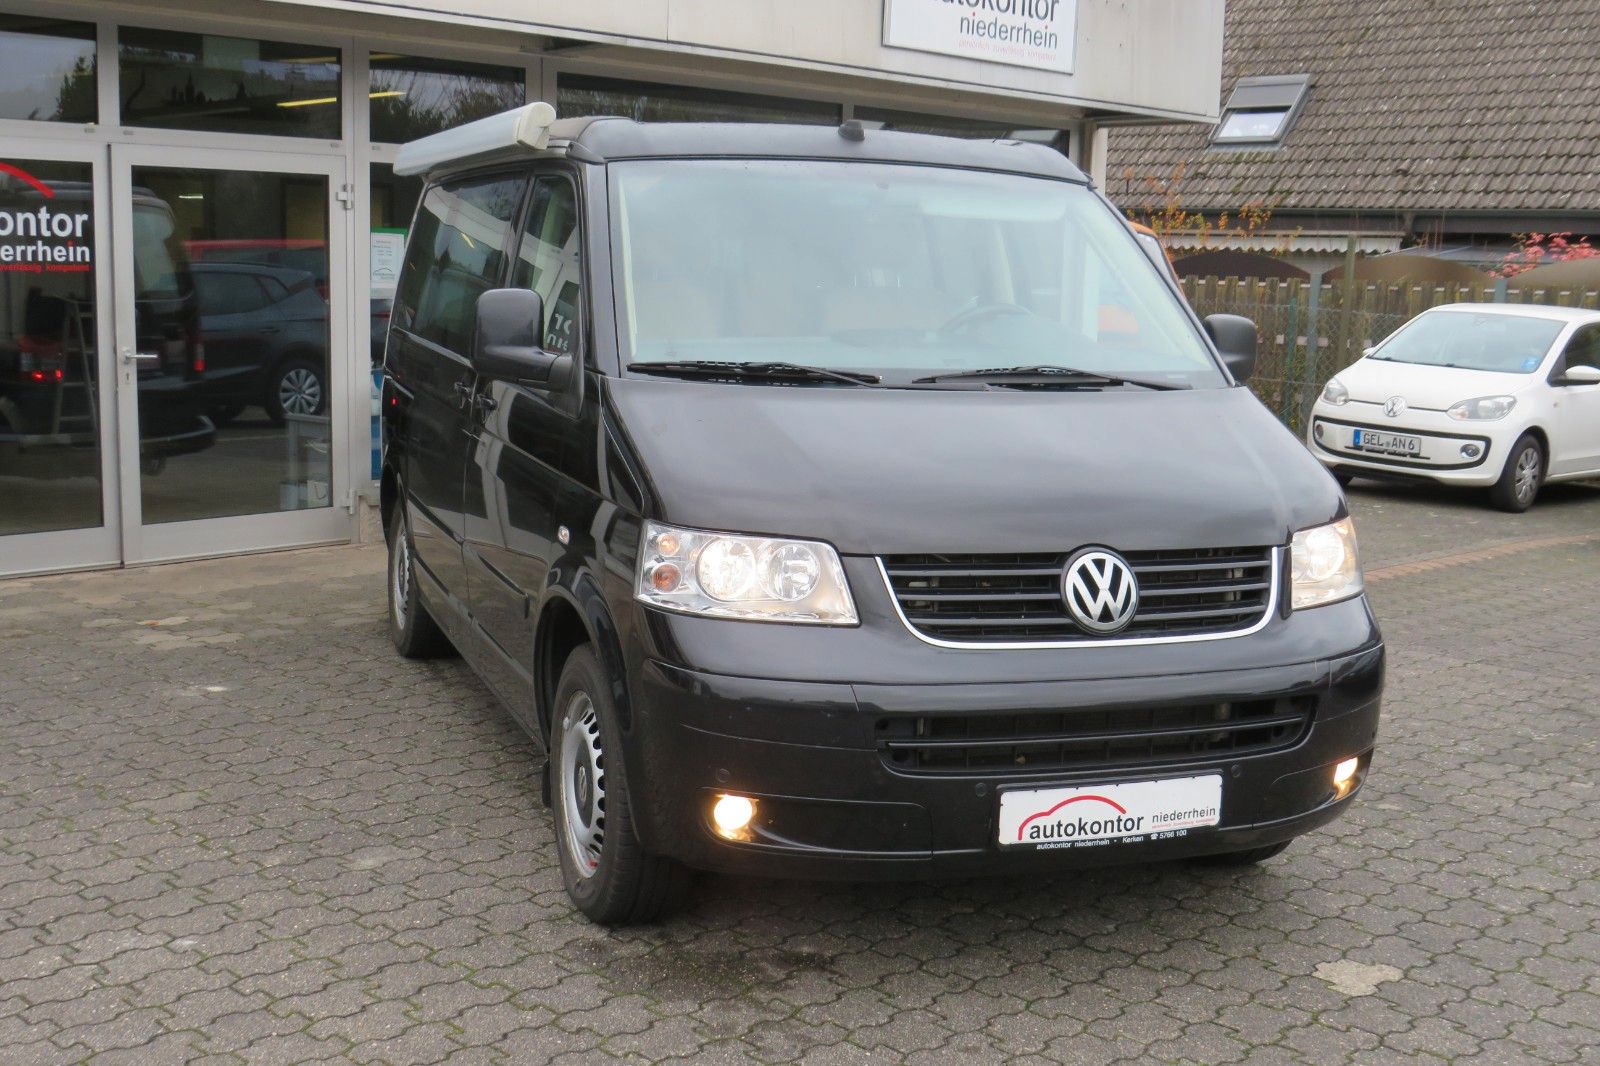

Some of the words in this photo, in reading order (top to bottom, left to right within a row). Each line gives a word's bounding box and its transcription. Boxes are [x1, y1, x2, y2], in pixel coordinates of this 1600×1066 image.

[960, 11, 1058, 49] niederrhein
[0, 240, 90, 262] errhein
[1363, 432, 1384, 447] GEL
[1392, 437, 1406, 450] AN
[1408, 439, 1415, 451] 6
[1029, 814, 1144, 840] autokontor
[1152, 806, 1216, 823] niederrhein
[1036, 841, 1072, 850] autokontor
[1074, 838, 1110, 848] niederrhein
